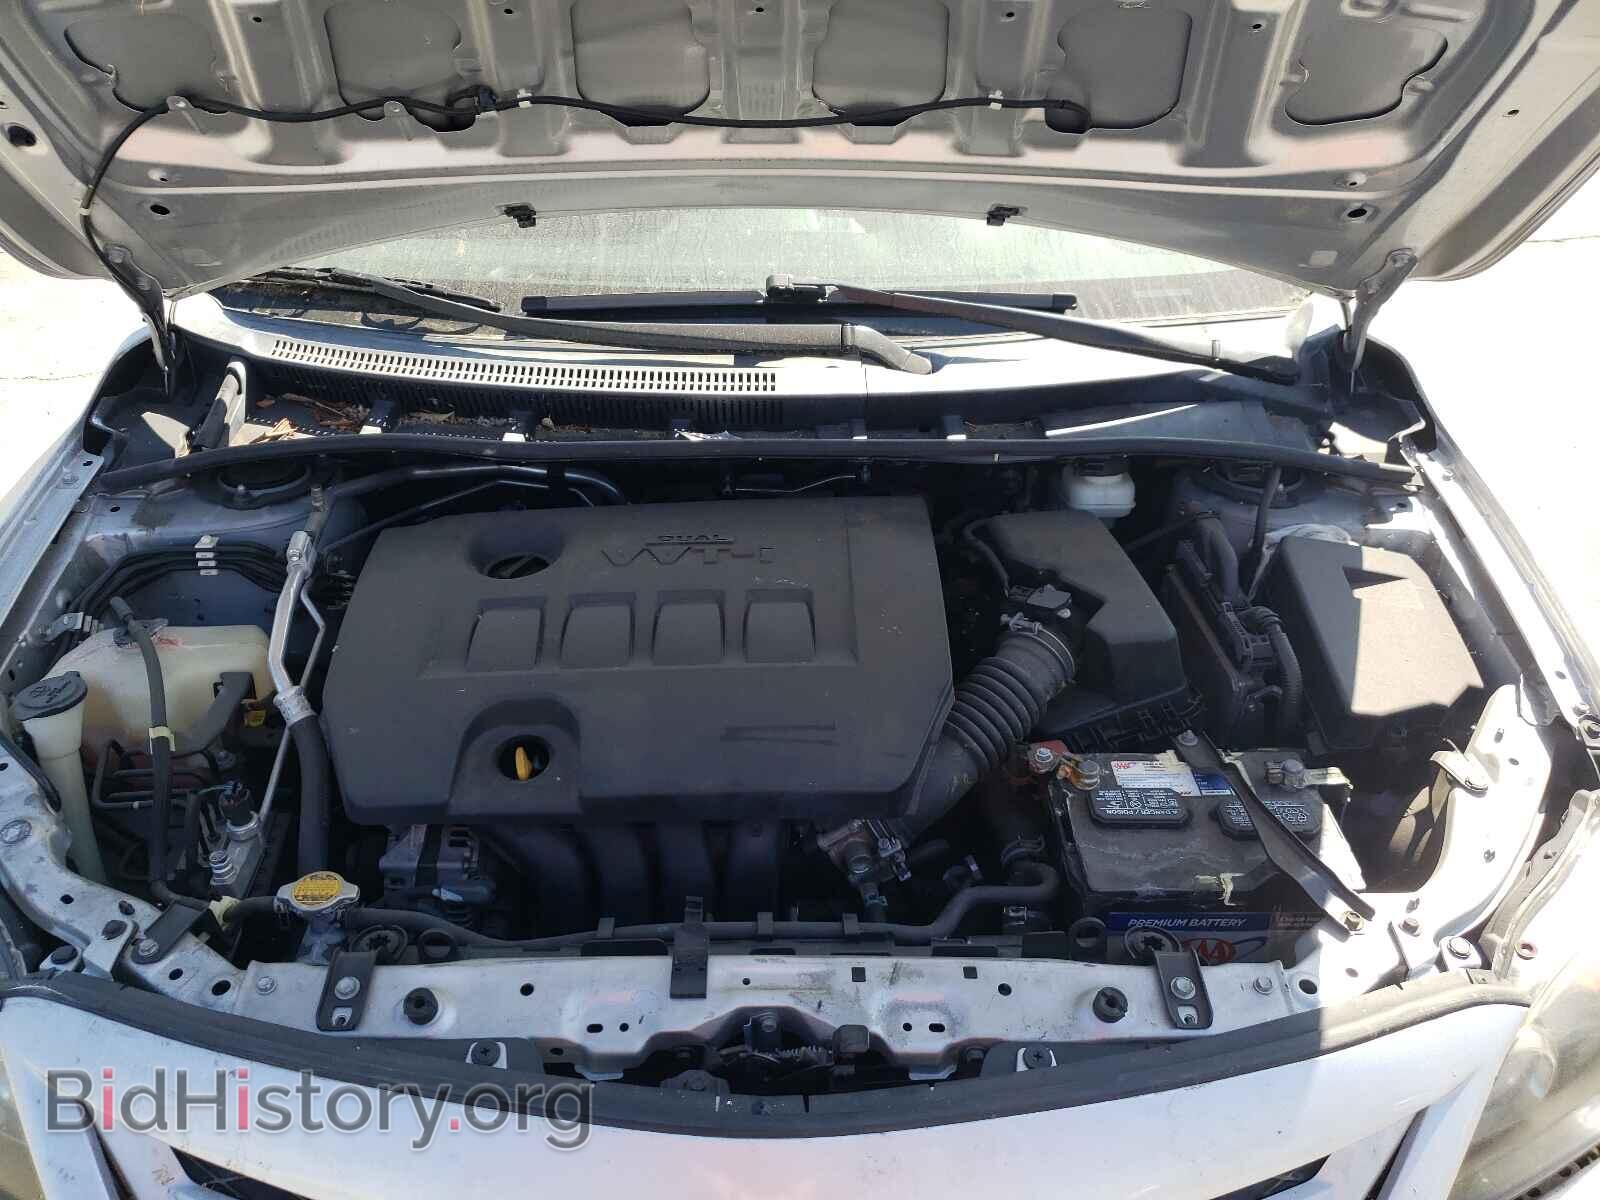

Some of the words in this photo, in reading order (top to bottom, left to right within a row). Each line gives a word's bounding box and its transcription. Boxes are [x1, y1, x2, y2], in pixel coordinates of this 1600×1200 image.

[657, 534, 730, 542] DUAL
[1127, 918, 1187, 928] PREMIUM
[1187, 918, 1248, 927] BATTERY
